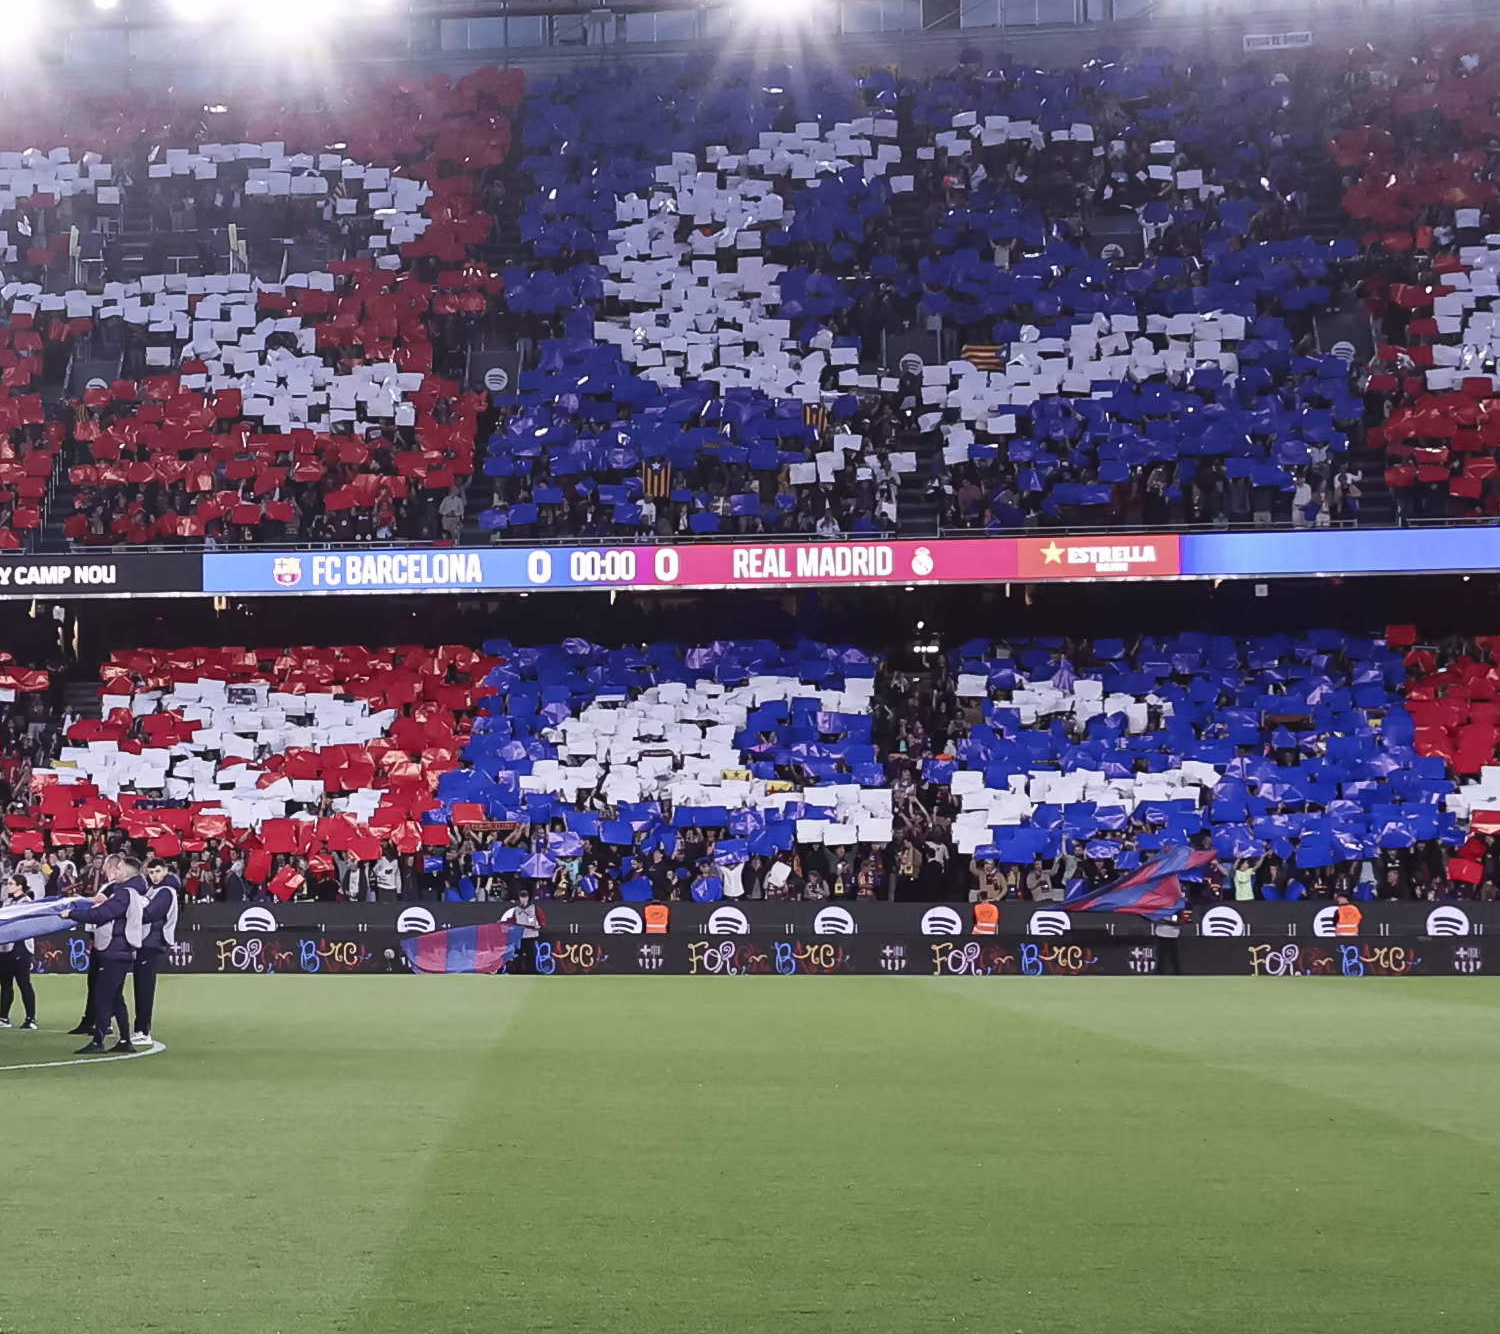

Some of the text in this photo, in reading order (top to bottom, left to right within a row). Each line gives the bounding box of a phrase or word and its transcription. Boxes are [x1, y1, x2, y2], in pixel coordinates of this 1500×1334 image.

[1067, 545, 1156, 563] ESTRELLA
[14, 566, 71, 585] CAMP
[74, 565, 116, 584] NOU
[312, 546, 893, 586] FC BARCELONA 0 00:00 0 REAL MADRID
